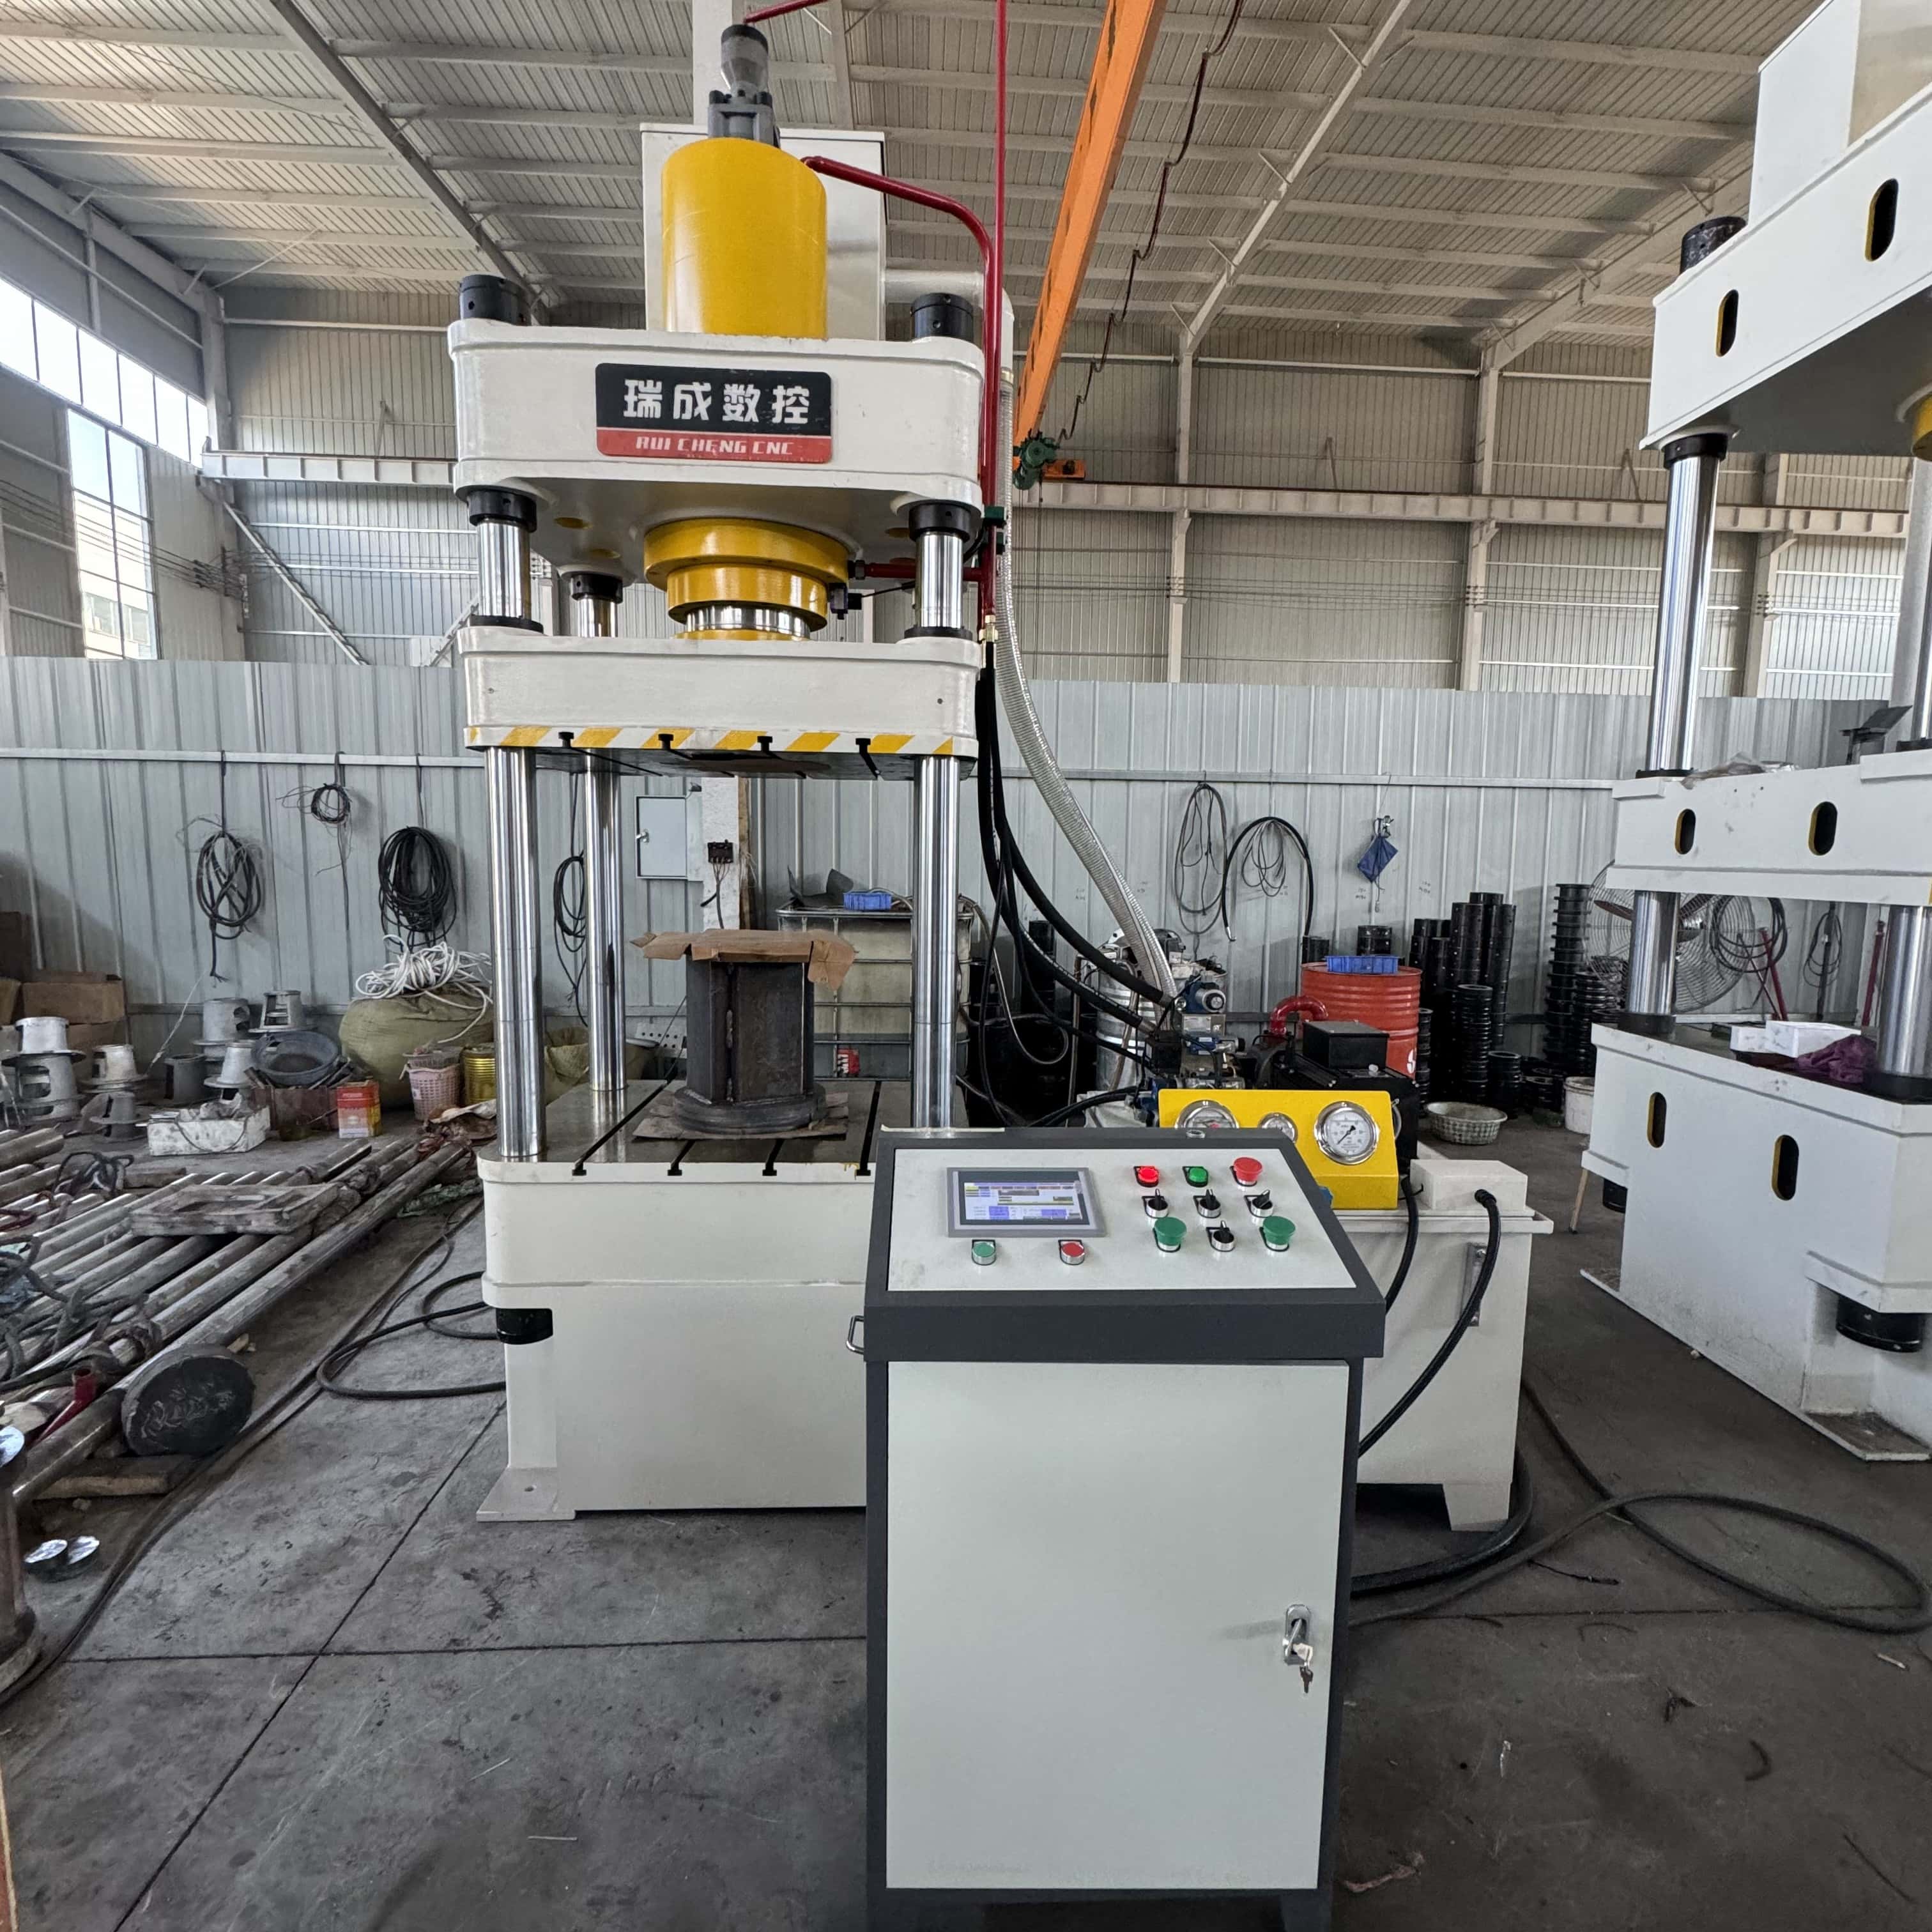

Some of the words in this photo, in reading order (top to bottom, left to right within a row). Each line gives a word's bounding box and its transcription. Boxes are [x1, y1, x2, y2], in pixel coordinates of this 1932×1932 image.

[623, 379, 810, 424] 瑞成数控
[636, 436, 671, 450] RUI
[677, 438, 747, 454] CHENG
[752, 441, 794, 455] CNC
